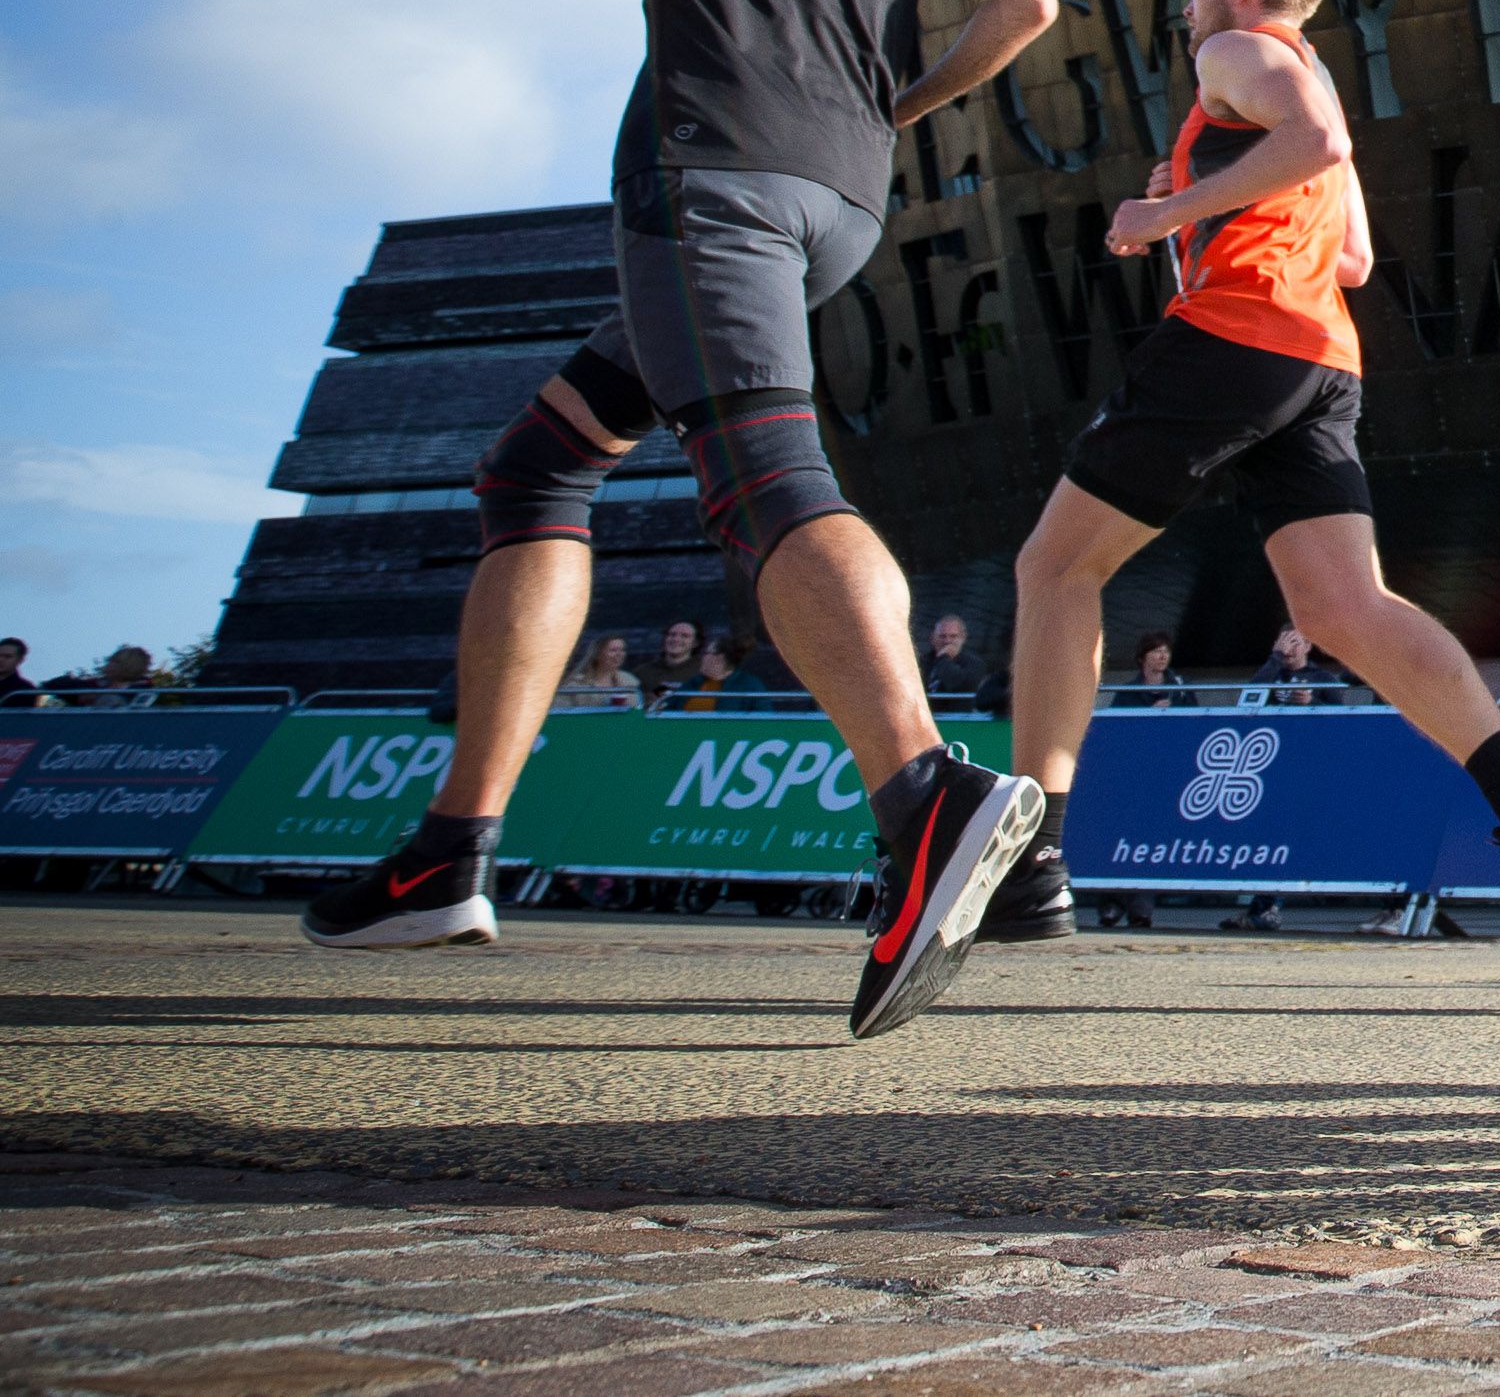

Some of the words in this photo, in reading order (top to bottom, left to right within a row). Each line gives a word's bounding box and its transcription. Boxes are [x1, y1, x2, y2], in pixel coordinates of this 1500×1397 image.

[38, 744, 126, 770] Cardiff
[113, 743, 222, 775] University
[665, 739, 870, 812] NSPC
[98, 785, 215, 820] Caerdydd
[276, 815, 370, 835] CYMRU
[650, 826, 750, 848] CYMRU
[791, 830, 877, 850] WALE
[1112, 837, 1290, 870] healthspan
